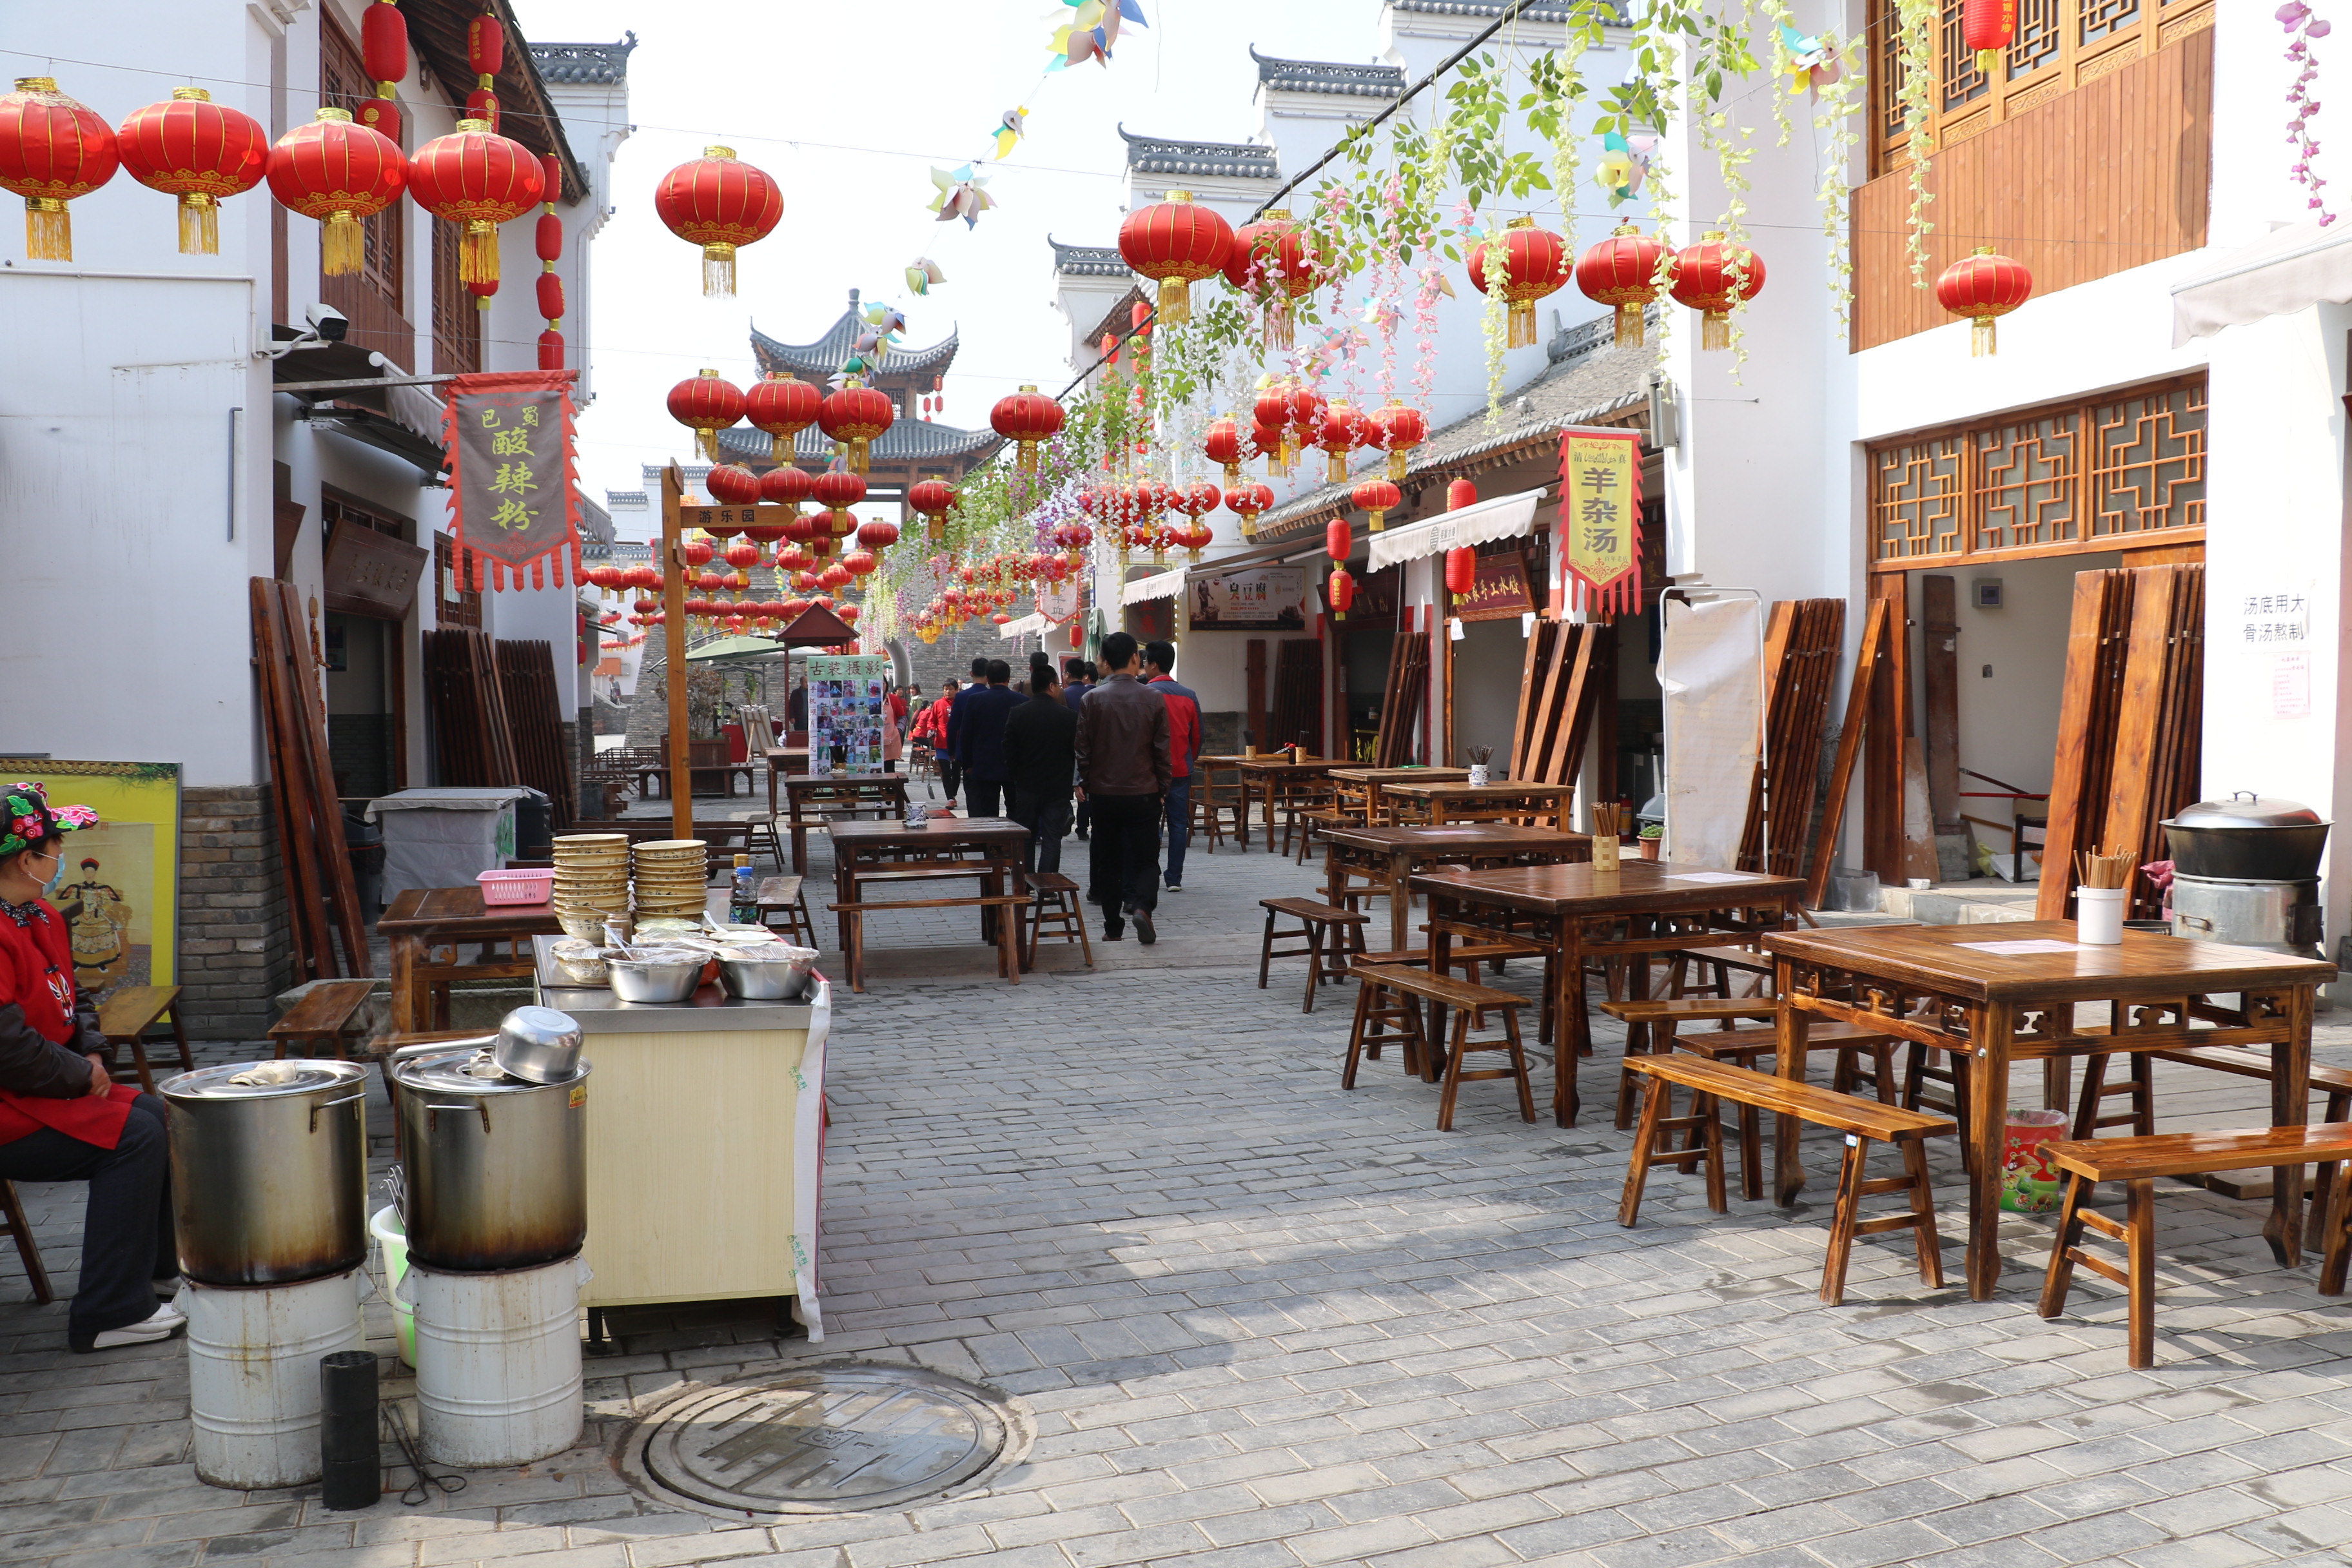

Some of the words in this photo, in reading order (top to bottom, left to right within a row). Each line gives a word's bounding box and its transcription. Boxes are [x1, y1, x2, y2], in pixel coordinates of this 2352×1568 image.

[481, 406, 539, 429] 巴蜀
[487, 426, 539, 531] 酸辣粉
[698, 509, 755, 524] 游乐园
[1581, 467, 1618, 553] 羊杂汤
[2244, 593, 2305, 615] 汤底用大
[2243, 621, 2304, 643] 骨汤熬制
[810, 660, 880, 676] 古装摄影
[809, 686, 818, 774] 手机照片一元一张
